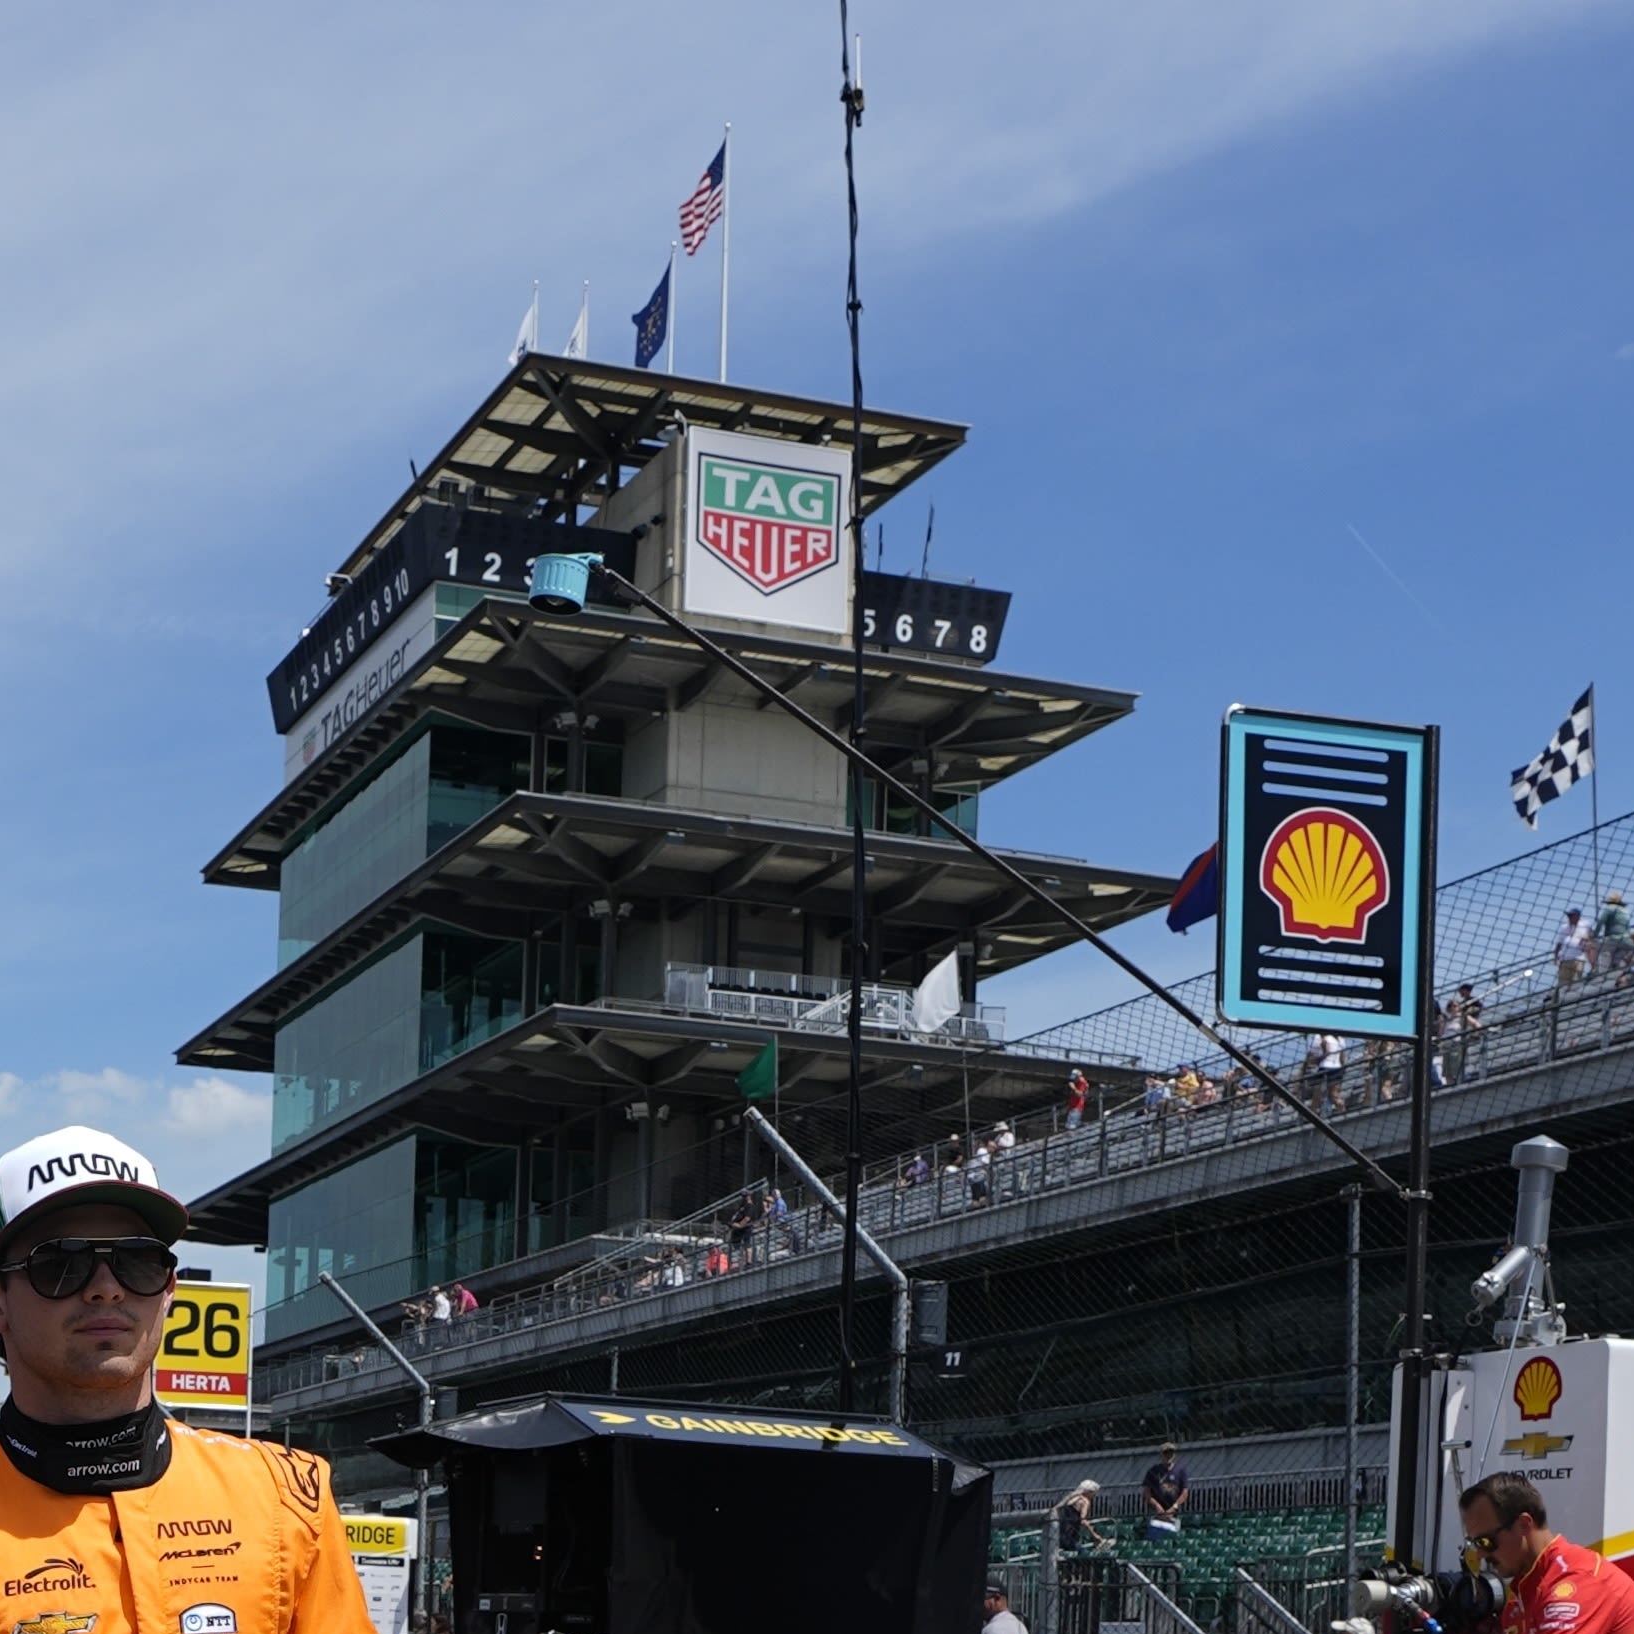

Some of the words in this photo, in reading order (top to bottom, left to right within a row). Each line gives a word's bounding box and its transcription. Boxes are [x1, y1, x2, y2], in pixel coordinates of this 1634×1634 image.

[712, 467, 824, 520] TAG
[444, 547, 459, 576] 1
[481, 552, 502, 582] 2
[707, 515, 828, 582] HEUER
[290, 687, 298, 711] 1
[300, 676, 309, 702] 2
[311, 664, 320, 690] 3
[323, 652, 331, 677] 4
[334, 638, 343, 665] 5
[346, 626, 355, 652] 6
[357, 612, 366, 640] 7
[371, 599, 380, 627] 8
[383, 586, 393, 613] 9
[394, 568, 409, 602] 10
[895, 614, 914, 642] 6
[934, 620, 951, 648] 7
[969, 625, 988, 653] 8
[27, 1153, 138, 1193] ARROW
[164, 1300, 240, 1359] 26
[944, 1351, 961, 1367] 11
[171, 1373, 231, 1392] HERTA
[645, 1414, 909, 1446] GAINBRIDGE
[67, 1459, 140, 1477] arrow.com
[157, 1518, 232, 1540] ARROW
[158, 1543, 240, 1562] McLaren
[169, 1577, 211, 1587] INDYCAR
[206, 1615, 231, 1627] NTT
